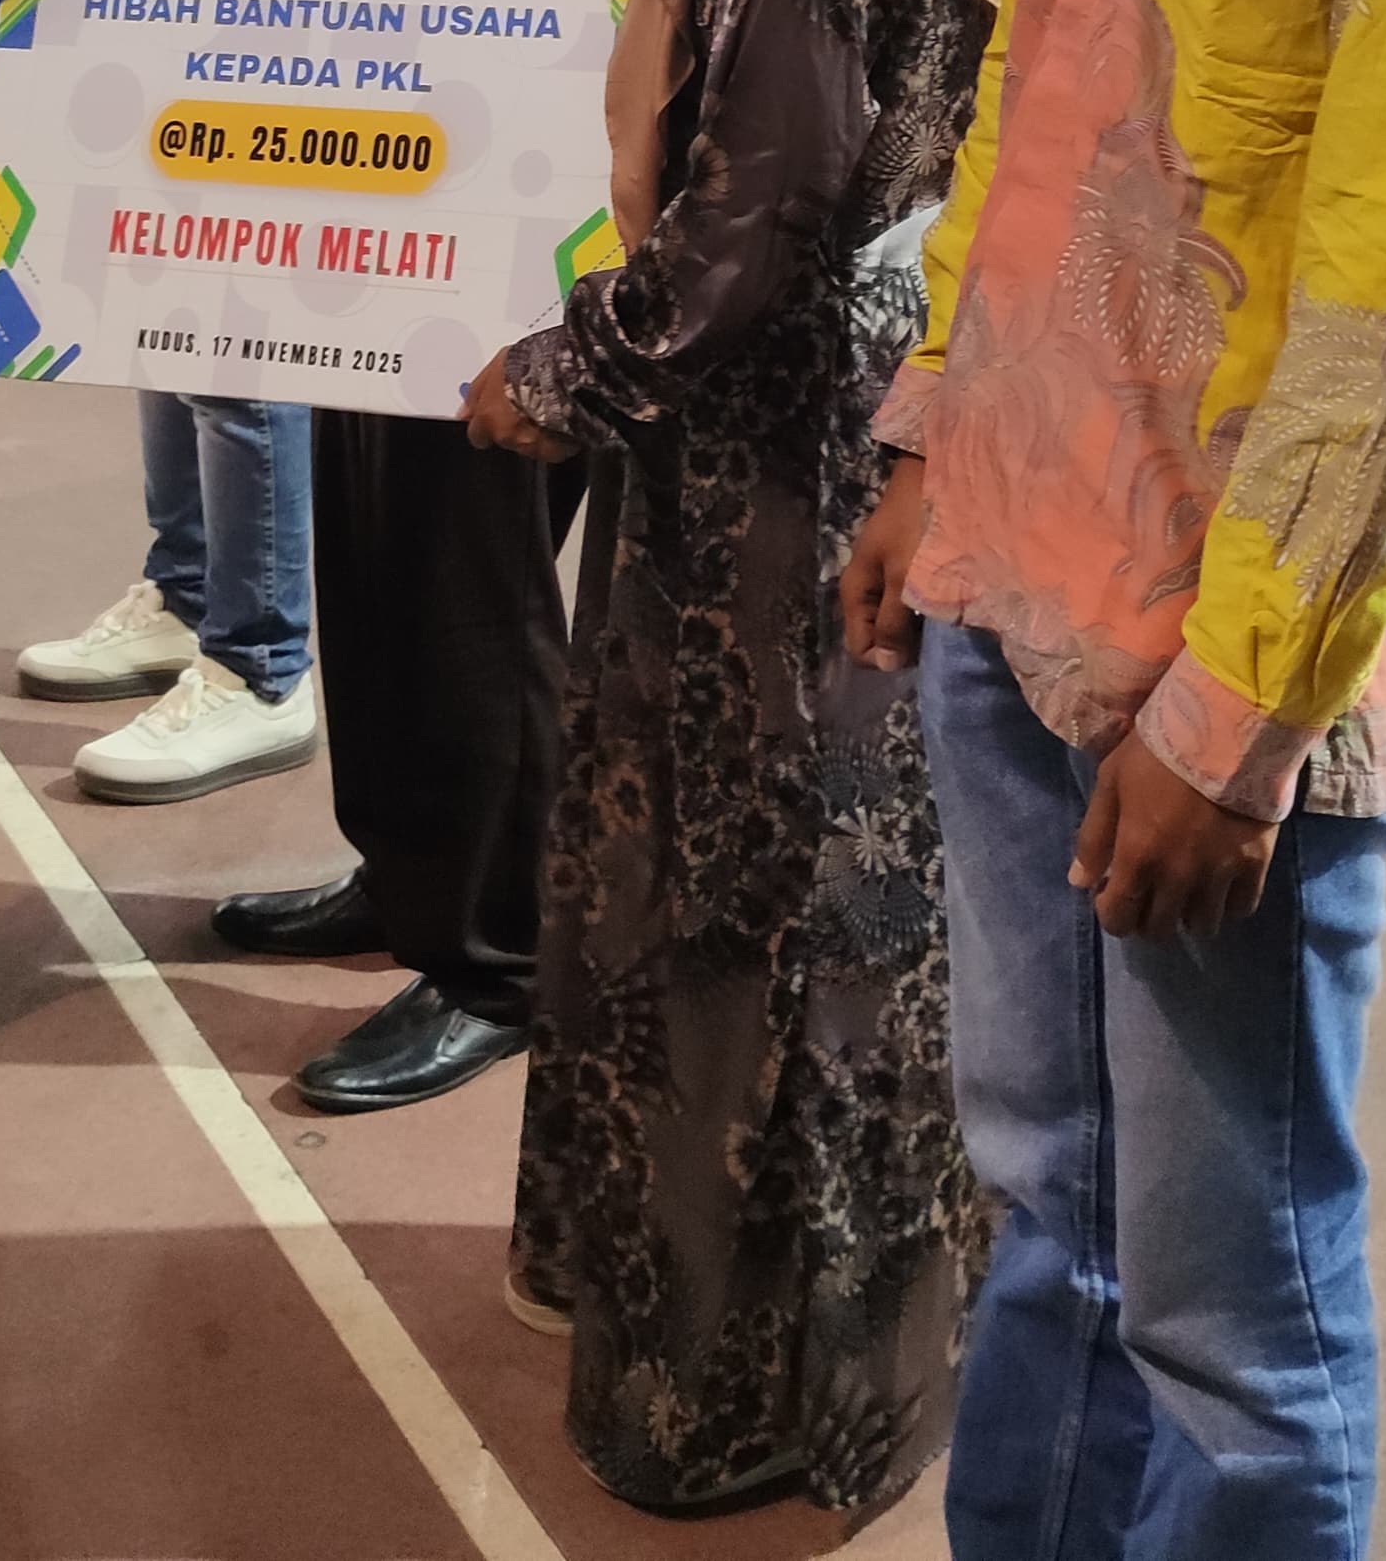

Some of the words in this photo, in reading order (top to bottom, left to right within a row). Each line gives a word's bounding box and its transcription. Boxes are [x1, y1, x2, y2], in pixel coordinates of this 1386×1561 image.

[419, 5, 561, 38] USAHA
[185, 52, 341, 89] KEPADA
[355, 59, 432, 93] PKL
[159, 120, 235, 164] @Rp.
[249, 125, 432, 172] 25.000.000
[109, 209, 303, 268] KELOMPOK
[317, 224, 458, 281] MELATI
[137, 328, 201, 357] KUDUS,
[213, 335, 232, 357] 17
[241, 339, 342, 369] NOVEMBER
[352, 349, 403, 374] 2025
